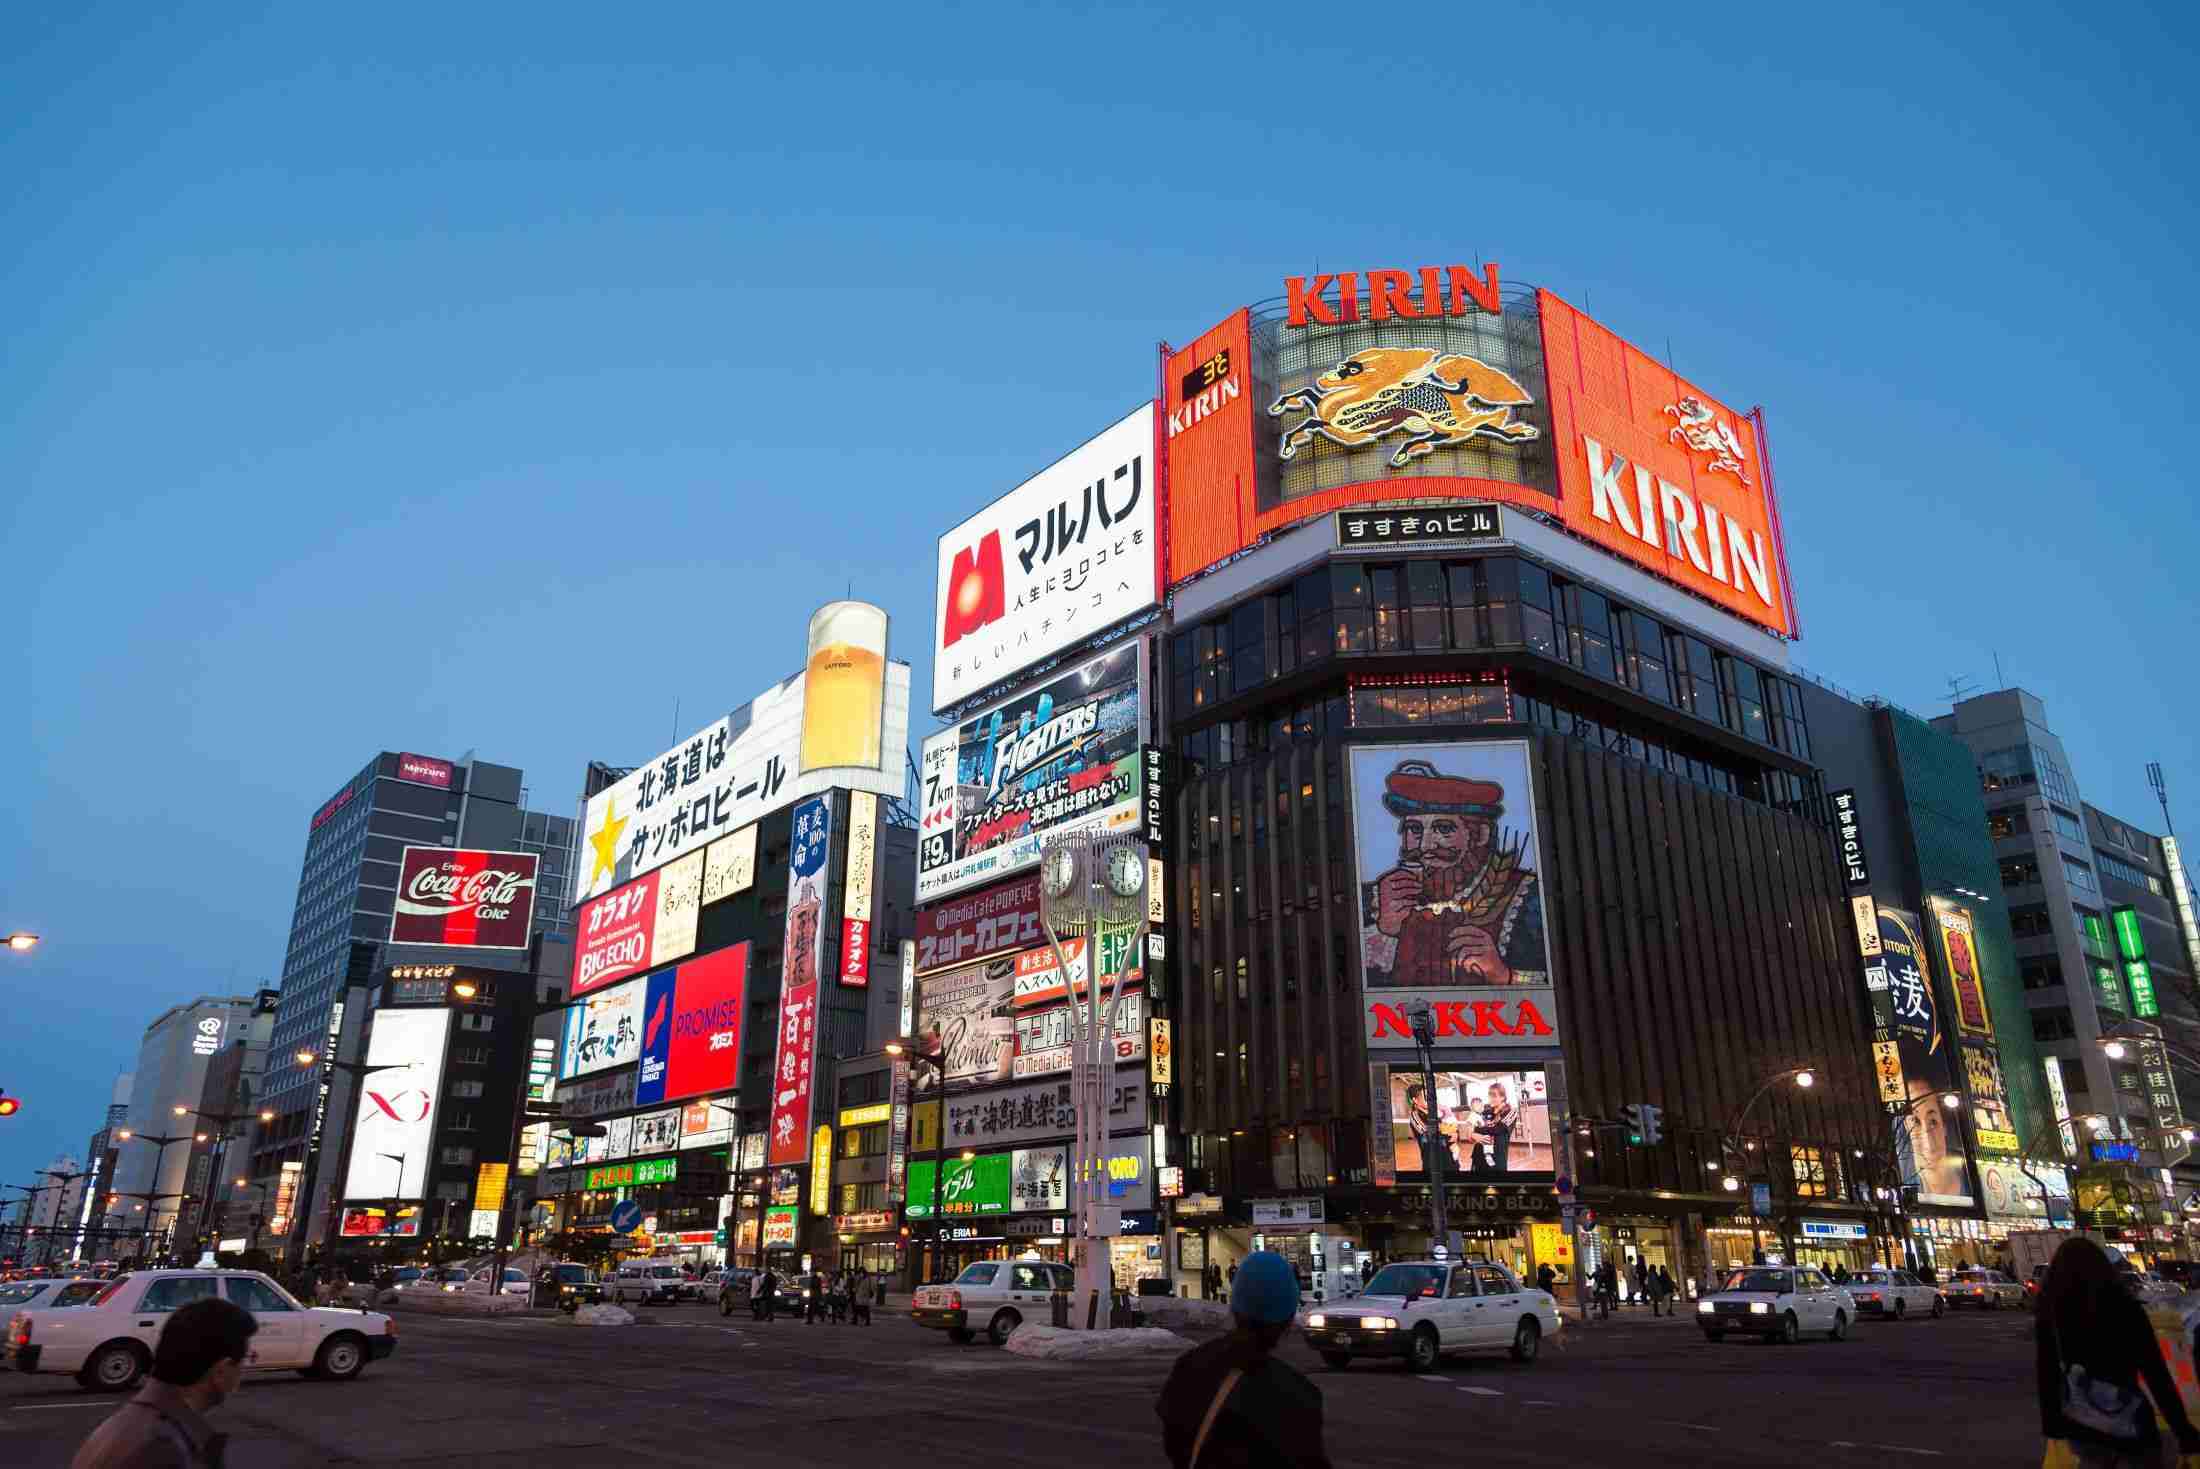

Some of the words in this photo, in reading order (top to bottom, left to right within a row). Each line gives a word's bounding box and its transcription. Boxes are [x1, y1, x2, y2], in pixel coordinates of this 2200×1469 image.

[1286, 264, 1501, 329] KIRIN
[1167, 373, 1240, 440] KIRIN
[1014, 455, 1142, 576] マルハン
[1347, 511, 1492, 539] すすきのビル
[1583, 433, 1773, 608] KIRIN
[1013, 529, 1144, 612] 人生にヨロコビを
[404, 763, 447, 778] Mercure
[635, 725, 728, 813] 北海道は
[985, 700, 1099, 804] FIGHTERS
[631, 754, 787, 868] サッポロビール
[963, 778, 1071, 831] ファイターズを見ずに
[1147, 750, 1162, 842] すすきのビル
[1836, 793, 1866, 882] すすきのビル
[474, 904, 510, 921] Coke
[587, 883, 649, 935] カラオケ
[579, 952, 606, 984] BIG
[606, 932, 646, 966] ECHO
[847, 921, 864, 974] カラオケ
[919, 911, 1040, 968] ネットカフェ
[675, 999, 737, 1039] PROMISE
[1369, 998, 1554, 1039] NKKA
[1153, 1083, 1170, 1097] 4F
